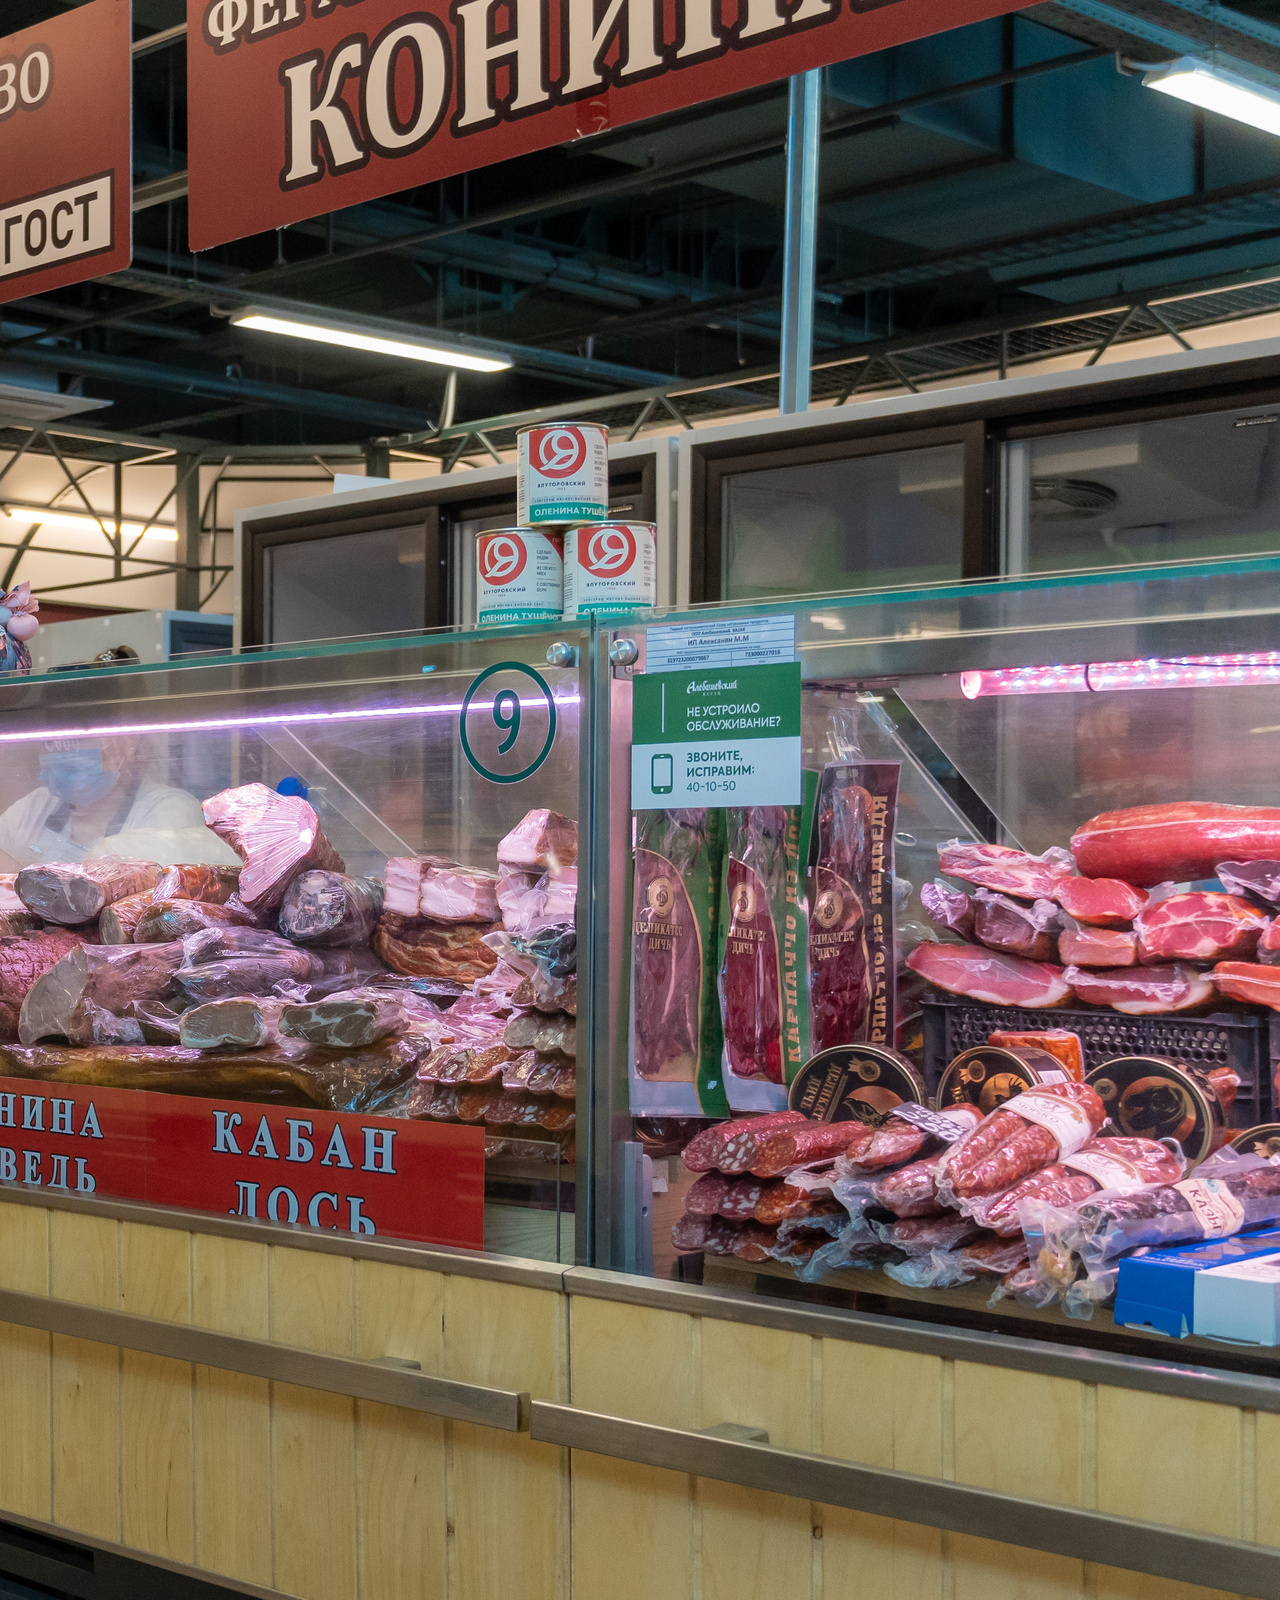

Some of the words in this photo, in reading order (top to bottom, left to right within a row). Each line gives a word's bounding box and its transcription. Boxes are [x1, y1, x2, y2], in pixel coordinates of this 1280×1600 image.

[207, 0, 331, 47] ФЕ
[283, 0, 831, 183] КОНИ
[3, 190, 99, 265] ГОСТ
[534, 507, 580, 517] ОЛЕНИНА
[483, 587, 526, 595] ЯЛУТОРОВСКИЙ
[481, 613, 519, 623] ОЛЕНИНА
[698, 637, 733, 646] Алексанян
[687, 706, 700, 717] НЕ
[702, 703, 761, 717] УСТРОИЛО
[492, 689, 521, 755] 9
[686, 716, 781, 731] ОБСЛУЖИВАНИЕ?
[686, 750, 743, 763] ЗВОНИТЕ,
[686, 765, 755, 777] ИСПРАВИМ:
[686, 780, 737, 792] 40-10-50
[871, 796, 888, 904] МЕДВЕДЯ
[785, 870, 798, 904] ИЗ
[648, 937, 672, 951] ДИЧЬ
[732, 942, 754, 955] ДИЧЬ
[784, 916, 802, 1062] КАРПАЧЧО
[212, 1110, 398, 1175] КАБАН
[228, 1179, 379, 1236] ЛОСЬ
[1189, 1189, 1222, 1231] КАЗЫ
